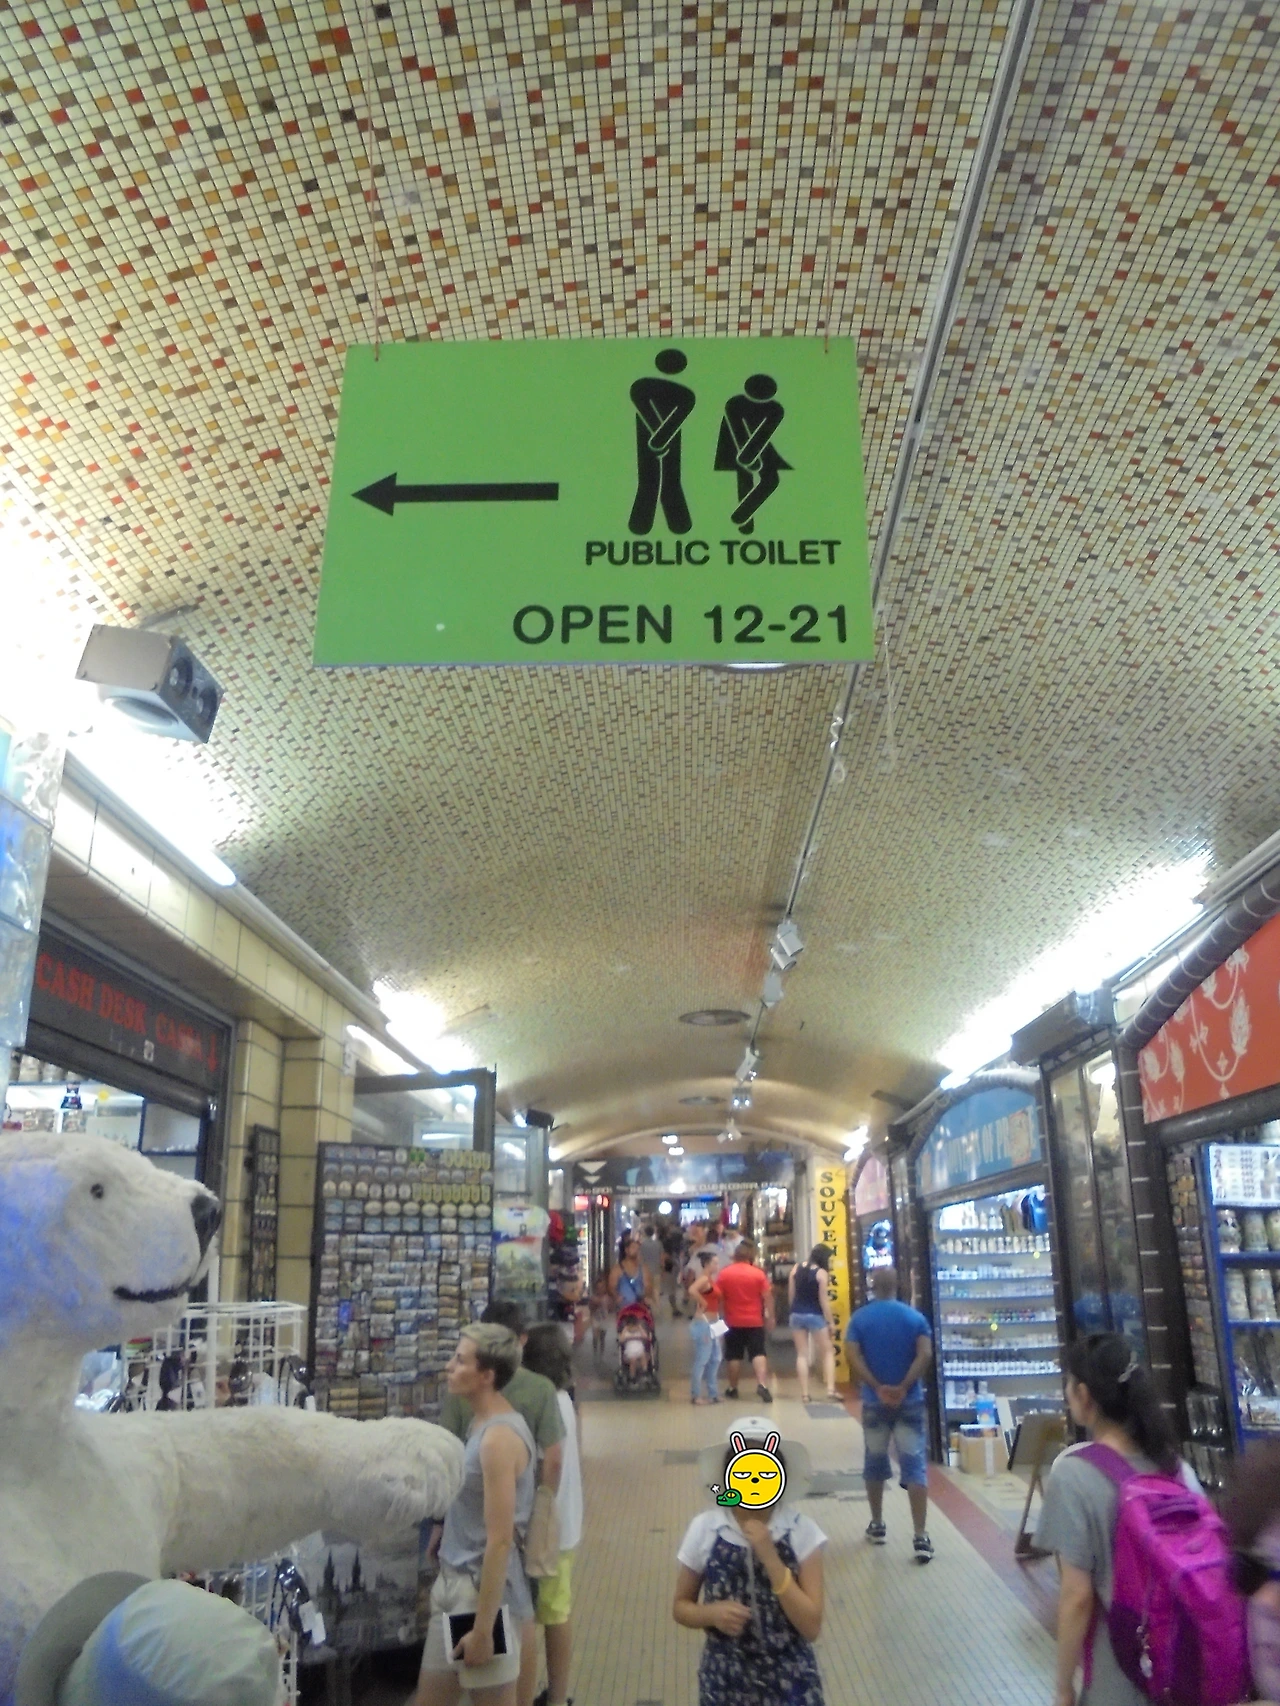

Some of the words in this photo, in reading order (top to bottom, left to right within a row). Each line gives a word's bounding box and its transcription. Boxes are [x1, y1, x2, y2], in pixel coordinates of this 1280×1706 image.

[585, 540, 710, 566] PUBLIC
[719, 539, 842, 566] TOILET
[512, 604, 673, 645] OPEN
[703, 604, 847, 645] 12-21
[36, 952, 95, 1012] CASH
[98, 983, 147, 1034] DESK
[818, 1171, 839, 1301] SOUVERS
